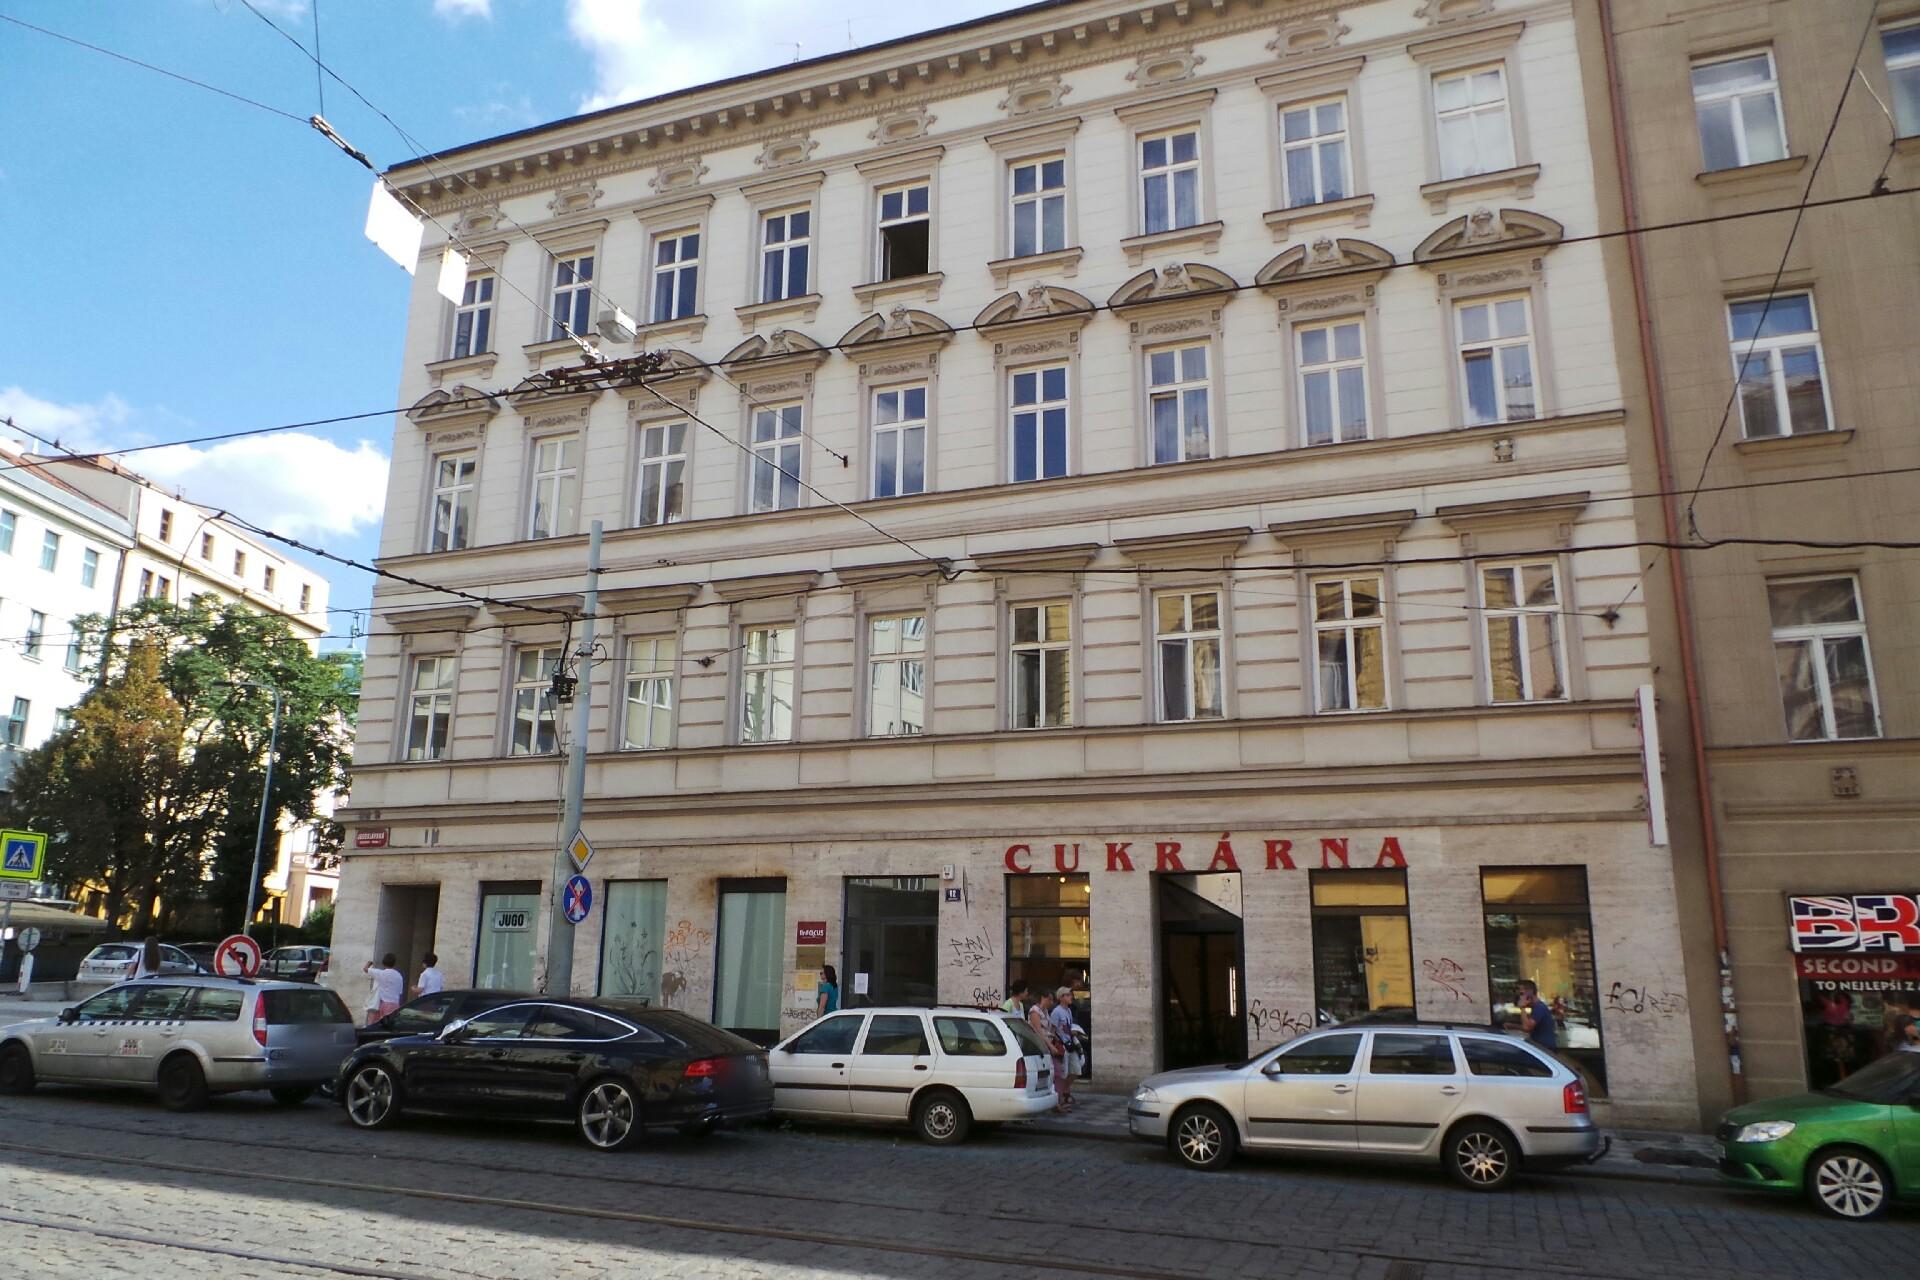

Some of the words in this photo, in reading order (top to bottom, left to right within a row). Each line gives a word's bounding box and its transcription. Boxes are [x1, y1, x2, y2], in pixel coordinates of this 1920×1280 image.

[1004, 831, 1409, 874] CUKRÁRNA
[949, 889, 957, 898] 12
[498, 913, 524, 927] JUGO
[1790, 895, 1920, 952] BR
[1803, 958, 1898, 974] SECOND
[1816, 981, 1836, 991] TO
[1904, 981, 1915, 991] Z
